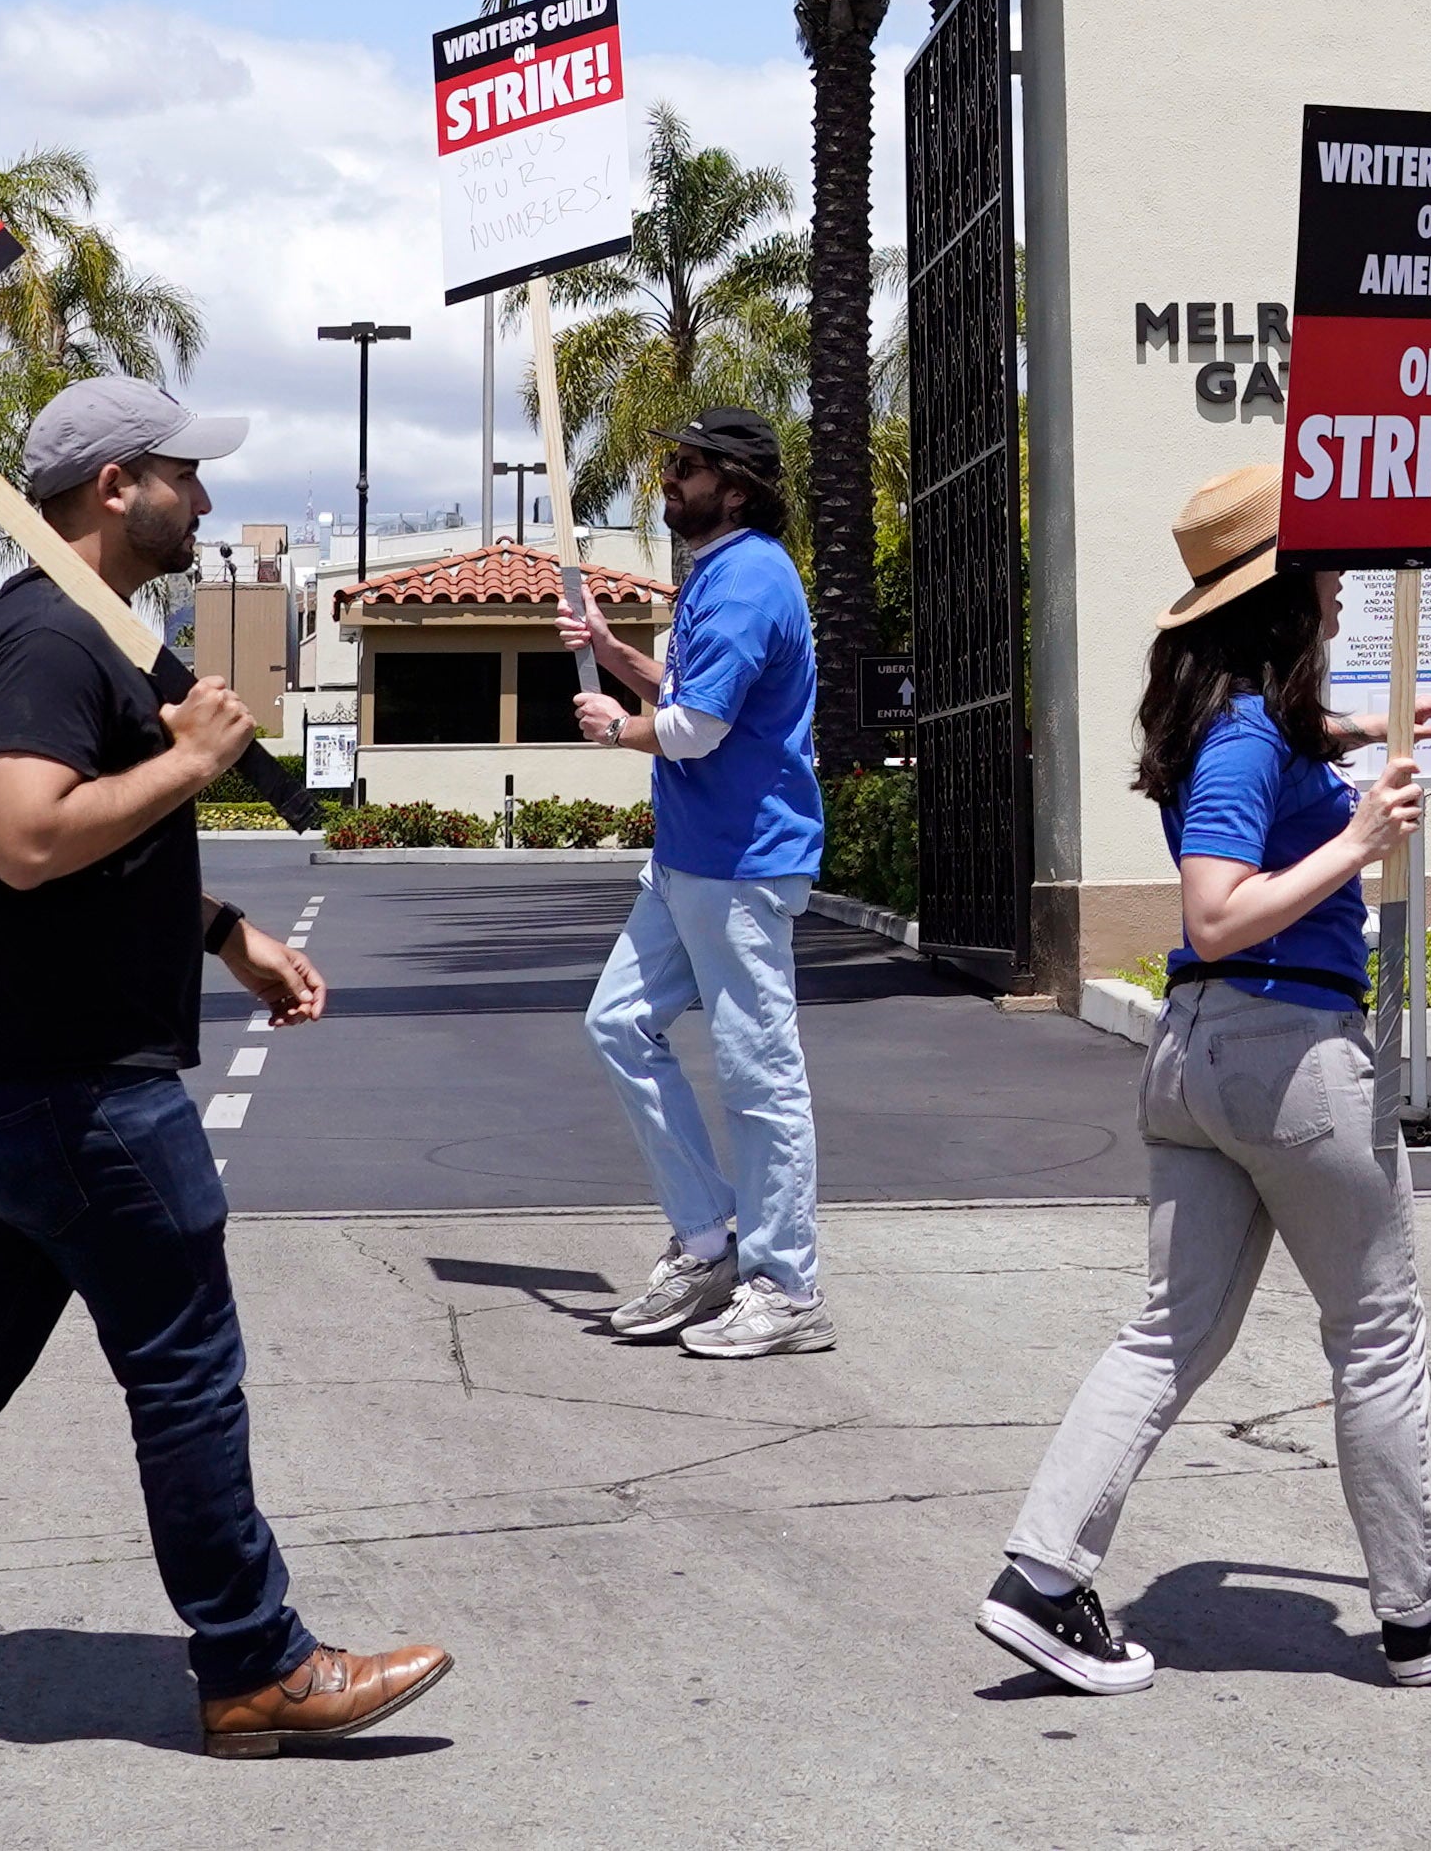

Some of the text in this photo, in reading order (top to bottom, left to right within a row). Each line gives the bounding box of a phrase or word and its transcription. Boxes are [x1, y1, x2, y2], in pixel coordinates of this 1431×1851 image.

[443, 12, 538, 64] WRITERS
[514, 43, 535, 64] ON
[444, 42, 614, 141] STRIKE!
[458, 124, 566, 178] SHOW US
[463, 161, 556, 222] YOUR
[470, 154, 612, 252] NUMBERS!
[1135, 302, 1291, 343] MELR
[1196, 362, 1289, 403] GA
[878, 664, 915, 674] UBER/T
[878, 709, 915, 718] ENTRA
